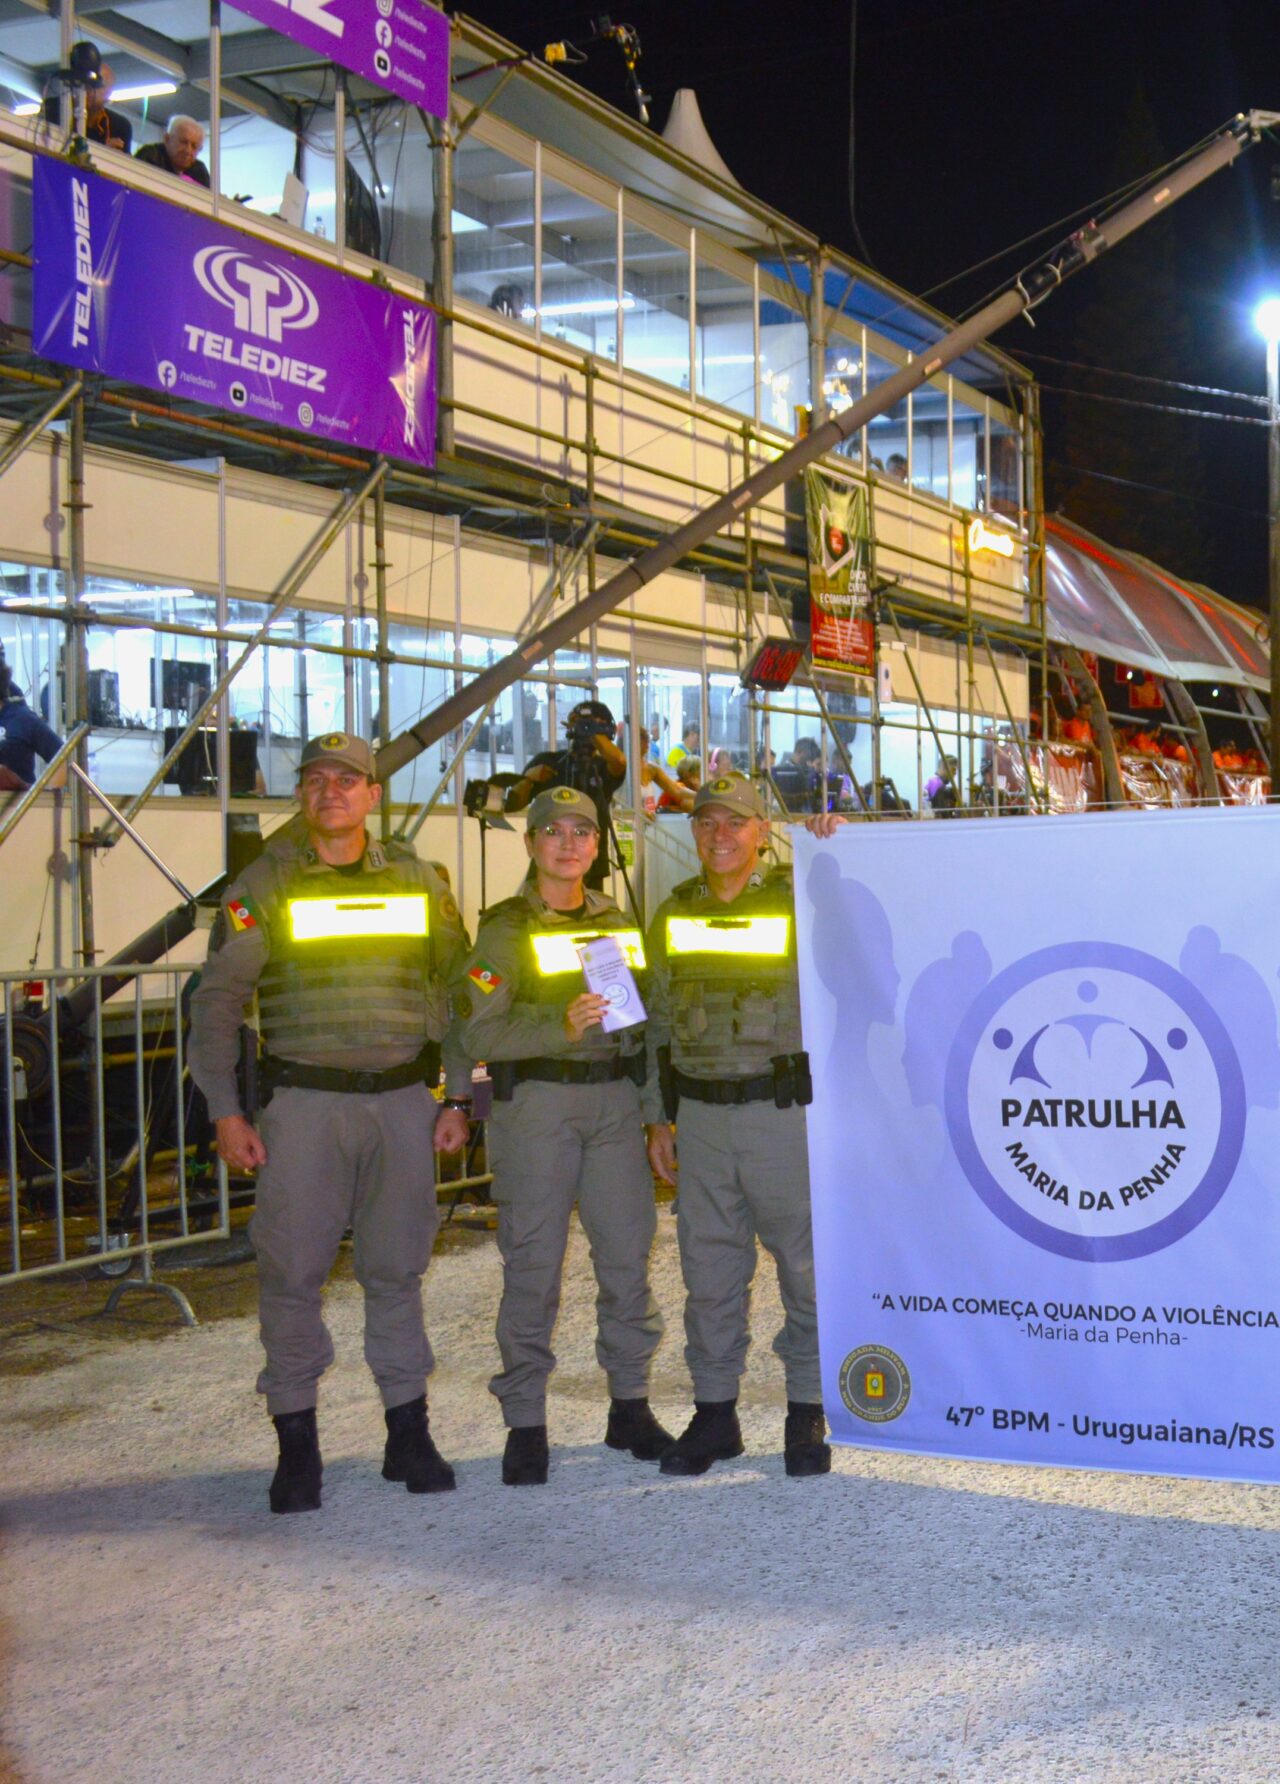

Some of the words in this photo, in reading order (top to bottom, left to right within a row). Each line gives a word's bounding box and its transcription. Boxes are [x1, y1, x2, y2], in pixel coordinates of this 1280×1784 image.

[72, 176, 93, 348] TELEDIEZ
[184, 324, 327, 393] TELEDIEZ
[1001, 1098, 1186, 1129] PATRULHA
[1004, 1141, 1069, 1206] MARIA
[1078, 1190, 1115, 1212] DA
[1118, 1141, 1187, 1207] PENHA
[899, 1295, 948, 1313] VIDA
[952, 1297, 1039, 1322] COMEÇA
[1043, 1302, 1136, 1322] QUANDO
[1141, 1306, 1157, 1323] A
[1162, 1304, 1280, 1328] VIOLÊNCIA
[1020, 1321, 1079, 1341] -Maria
[1084, 1326, 1109, 1343] da
[1116, 1327, 1188, 1345] Penha-
[992, 1408, 1050, 1433] BPM
[1072, 1414, 1275, 1450] Uruguaiana/RS
